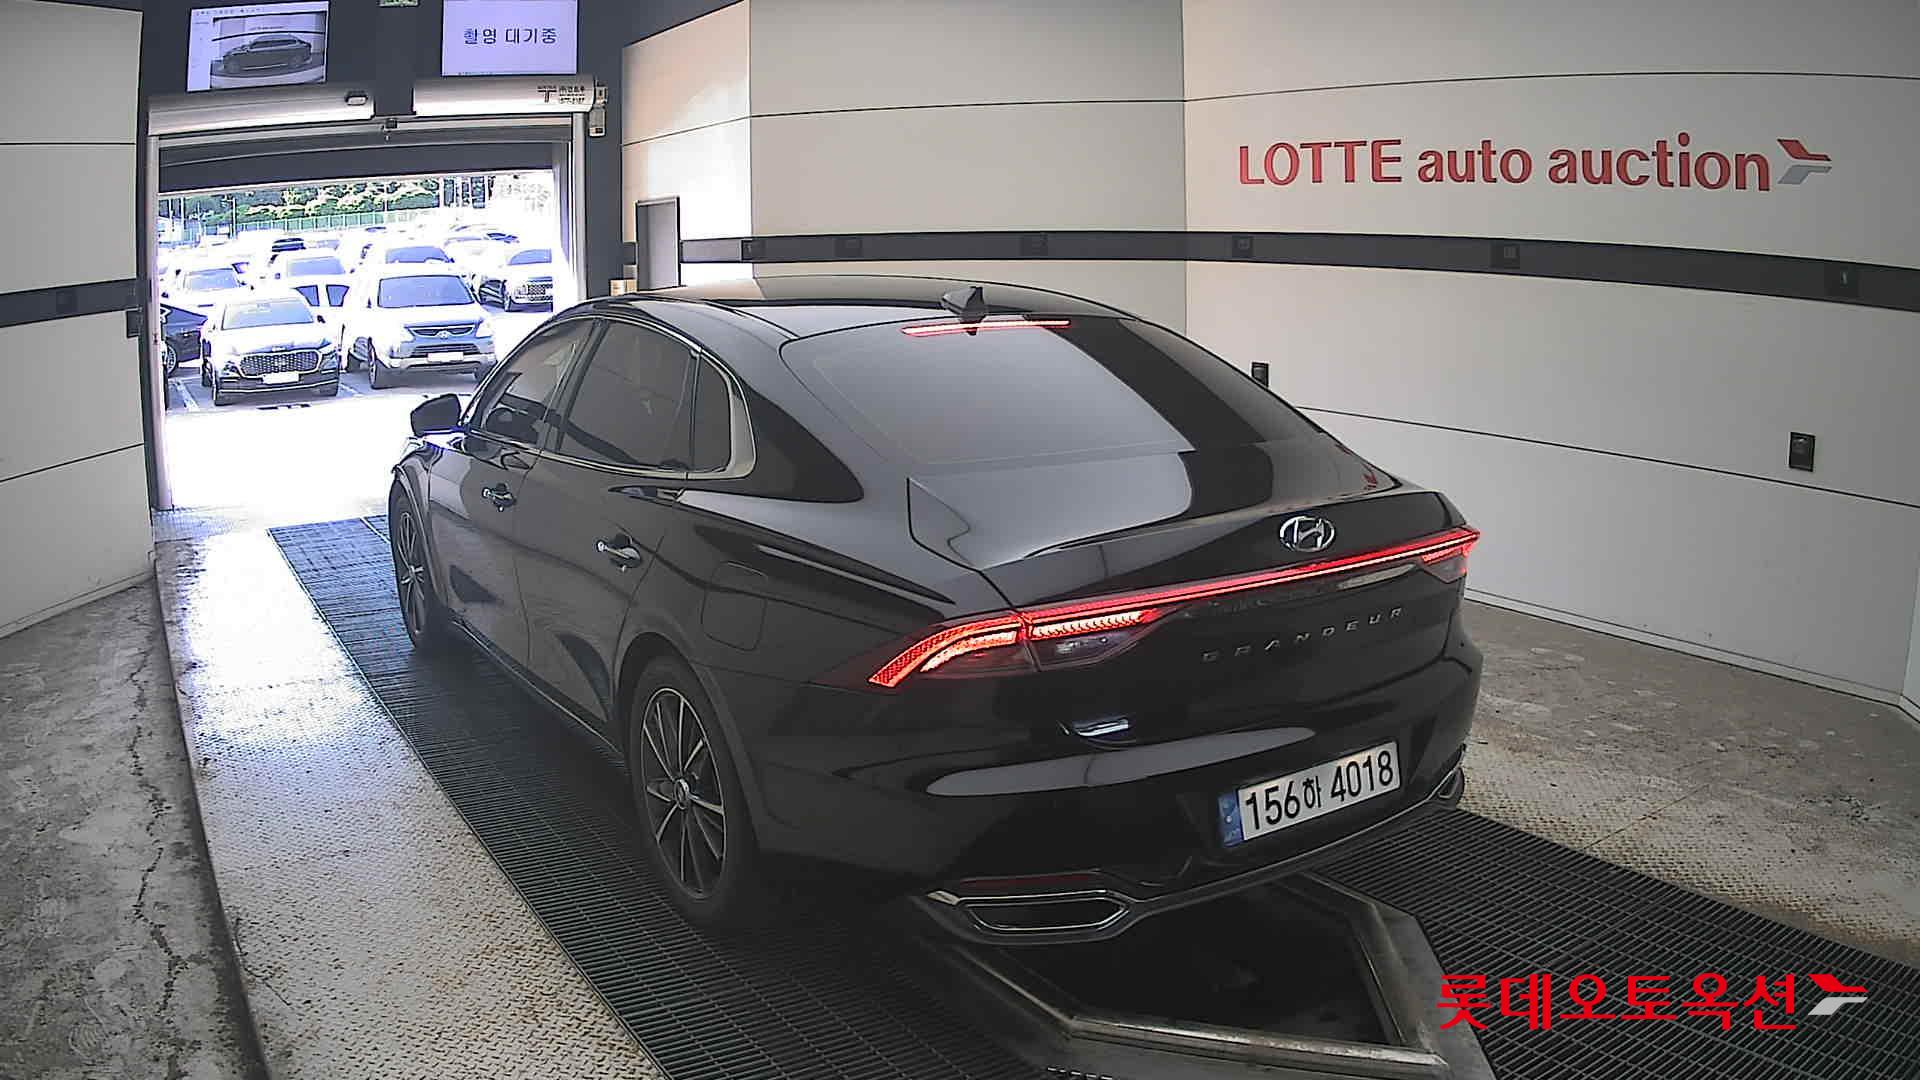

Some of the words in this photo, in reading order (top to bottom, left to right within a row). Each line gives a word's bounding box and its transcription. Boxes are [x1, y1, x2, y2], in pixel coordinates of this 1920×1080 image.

[505, 28, 557, 44] 대기중
[1239, 138, 1402, 186] LOTTE
[1417, 139, 1533, 185] auto
[1548, 133, 1770, 192] auction
[1202, 607, 1403, 662] GRANDEUR
[1245, 775, 1322, 830] 156하
[1330, 749, 1394, 803] 4018
